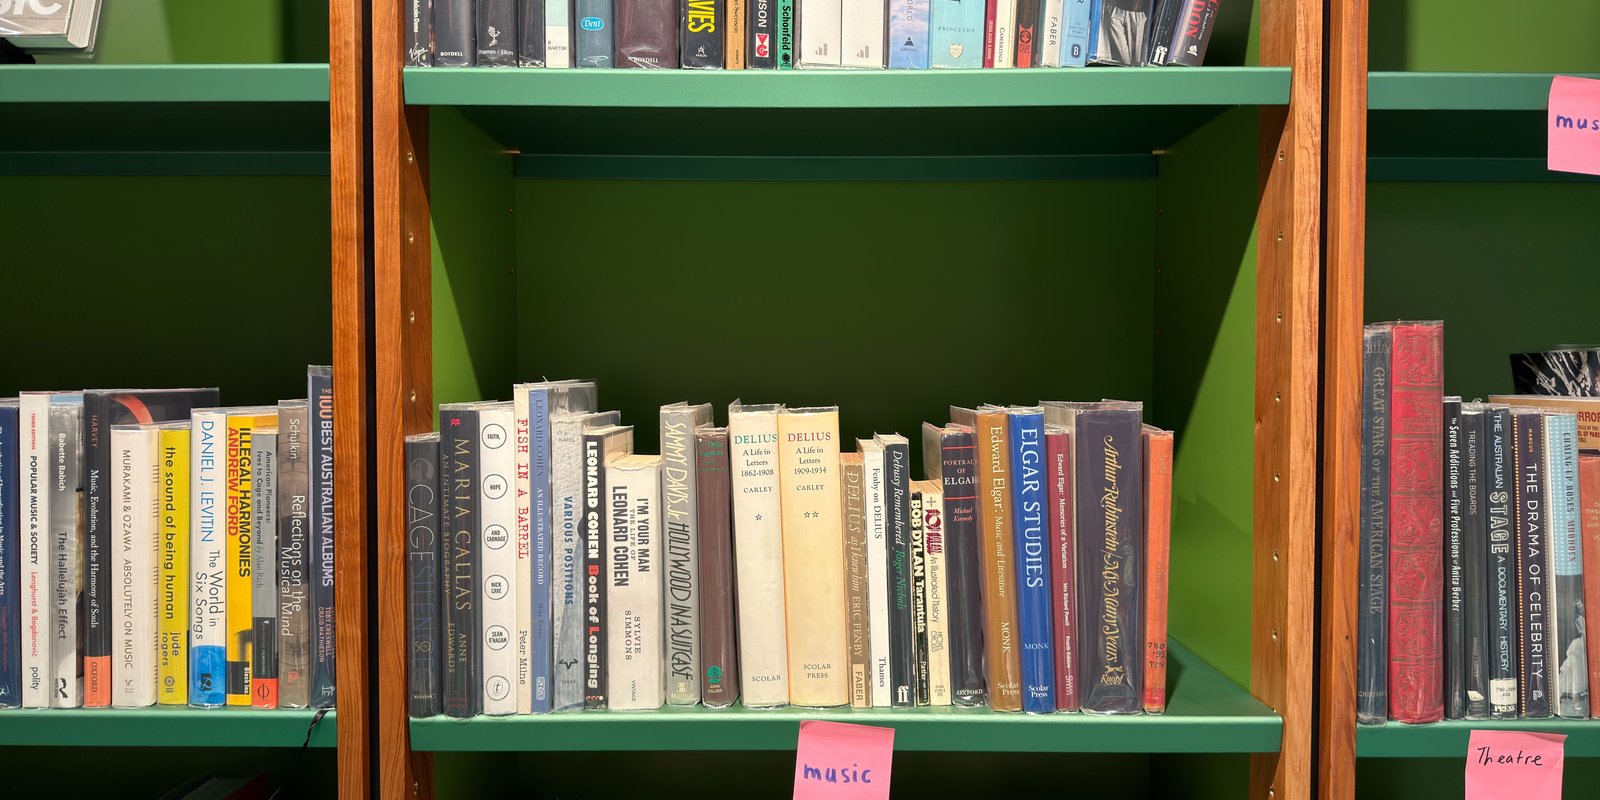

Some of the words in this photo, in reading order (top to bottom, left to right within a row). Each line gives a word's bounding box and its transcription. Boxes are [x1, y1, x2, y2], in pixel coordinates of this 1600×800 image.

[584, 18, 601, 28] Dent
[782, 5, 791, 50] Schonfeld
[1049, 16, 1058, 46] FABER
[1556, 114, 1599, 131] mus
[290, 418, 300, 460] Schulkin
[518, 418, 529, 454] FISH
[734, 434, 777, 445] DELIUS
[788, 432, 831, 442] DELIUS
[1450, 425, 1459, 448] Seven
[1494, 413, 1503, 433] THE
[165, 447, 176, 468] the
[200, 420, 214, 473] DANIEL
[228, 427, 239, 492] ANDREW
[239, 427, 251, 486] ILLEGAL
[990, 426, 1004, 473] Edward
[1019, 428, 1039, 496] ELGAR
[1469, 429, 1477, 468] TREADING
[1494, 435, 1503, 489] AUSTRALIAN
[1563, 432, 1573, 467] COMING
[30, 455, 38, 494] POPULAR
[123, 449, 131, 503] MURAKAMI
[200, 475, 214, 486] J.
[455, 437, 471, 518] MARIA
[518, 462, 529, 481] IN
[587, 441, 599, 508] LEONARD
[1450, 449, 1461, 489] Addictions
[1469, 469, 1477, 483] THE
[1527, 463, 1537, 493] THE
[1565, 470, 1573, 481] UP
[165, 471, 176, 512] sound
[518, 489, 529, 497] A
[637, 498, 649, 515] I'M
[743, 486, 773, 494] CARLEY
[990, 477, 1005, 513] Elgar:
[1450, 499, 1461, 514] Five
[1469, 484, 1477, 516] BOARDS
[1565, 485, 1575, 514] ROSES
[30, 495, 38, 522] MUSIC
[123, 504, 131, 512] &
[165, 515, 176, 529] of
[200, 491, 214, 542] LEVITIN
[228, 495, 239, 536] FORD
[564, 496, 573, 544] VARIOUS
[613, 485, 628, 542] LEONARD
[911, 499, 922, 528] BOB
[1490, 490, 1508, 554] STAGE
[58, 532, 68, 550] The
[123, 514, 131, 552] OZAWA
[239, 489, 251, 577] HARMONIES
[291, 495, 306, 566] Reflections
[518, 507, 529, 560] BARREL
[587, 511, 599, 559] COHEN
[637, 518, 649, 545] YOUR
[994, 515, 1003, 537] Music
[1060, 529, 1067, 537] of
[1450, 515, 1461, 558] Professions
[1528, 500, 1540, 558] DRAMA
[30, 531, 38, 565] SOCIETY
[163, 532, 176, 570] being
[209, 550, 220, 568] The
[637, 547, 649, 573] MAN
[913, 529, 925, 577] DYLAN
[996, 541, 1005, 557] and
[1024, 501, 1043, 588] STUDIES
[56, 553, 68, 606] Hallelujah
[195, 571, 208, 593] Six
[281, 546, 294, 599] Musical
[291, 570, 302, 587] on
[455, 529, 471, 611] CALLAS
[564, 547, 573, 606] POSITIONS
[613, 545, 628, 587] COHEN
[997, 559, 1006, 598] Literature
[1450, 564, 1461, 584] Anita
[1529, 564, 1541, 585] OF
[123, 558, 132, 618] ABSOLUTELY
[165, 574, 176, 620] human
[209, 570, 224, 614] World
[587, 564, 599, 604] Book
[1450, 586, 1461, 611] Berber
[1498, 566, 1508, 631] DOCUMENTARY
[291, 590, 306, 612] the
[587, 606, 599, 624] of
[916, 579, 926, 633] Tarantula
[58, 608, 68, 640] Effect
[123, 620, 132, 636] ON
[193, 598, 208, 640] Songs
[209, 617, 220, 627] in
[281, 602, 294, 636] Mind
[1530, 591, 1543, 679] CELEBRITY
[123, 638, 132, 669] MUSIC
[160, 631, 169, 667] rogers
[170, 631, 181, 657] jude
[520, 630, 528, 655] Peter
[1001, 621, 1011, 654] MONK
[1024, 642, 1049, 650] MONK
[1500, 635, 1509, 672] HISTORY
[520, 657, 528, 686] Milne
[587, 626, 599, 689] Longing
[878, 656, 887, 688] Thames
[30, 666, 40, 690] polity
[855, 671, 863, 701] FABER
[956, 688, 983, 696] OXFORD
[1100, 673, 1124, 686] Knopf
[1477, 746, 1543, 766] Theatre
[804, 763, 872, 783] music
